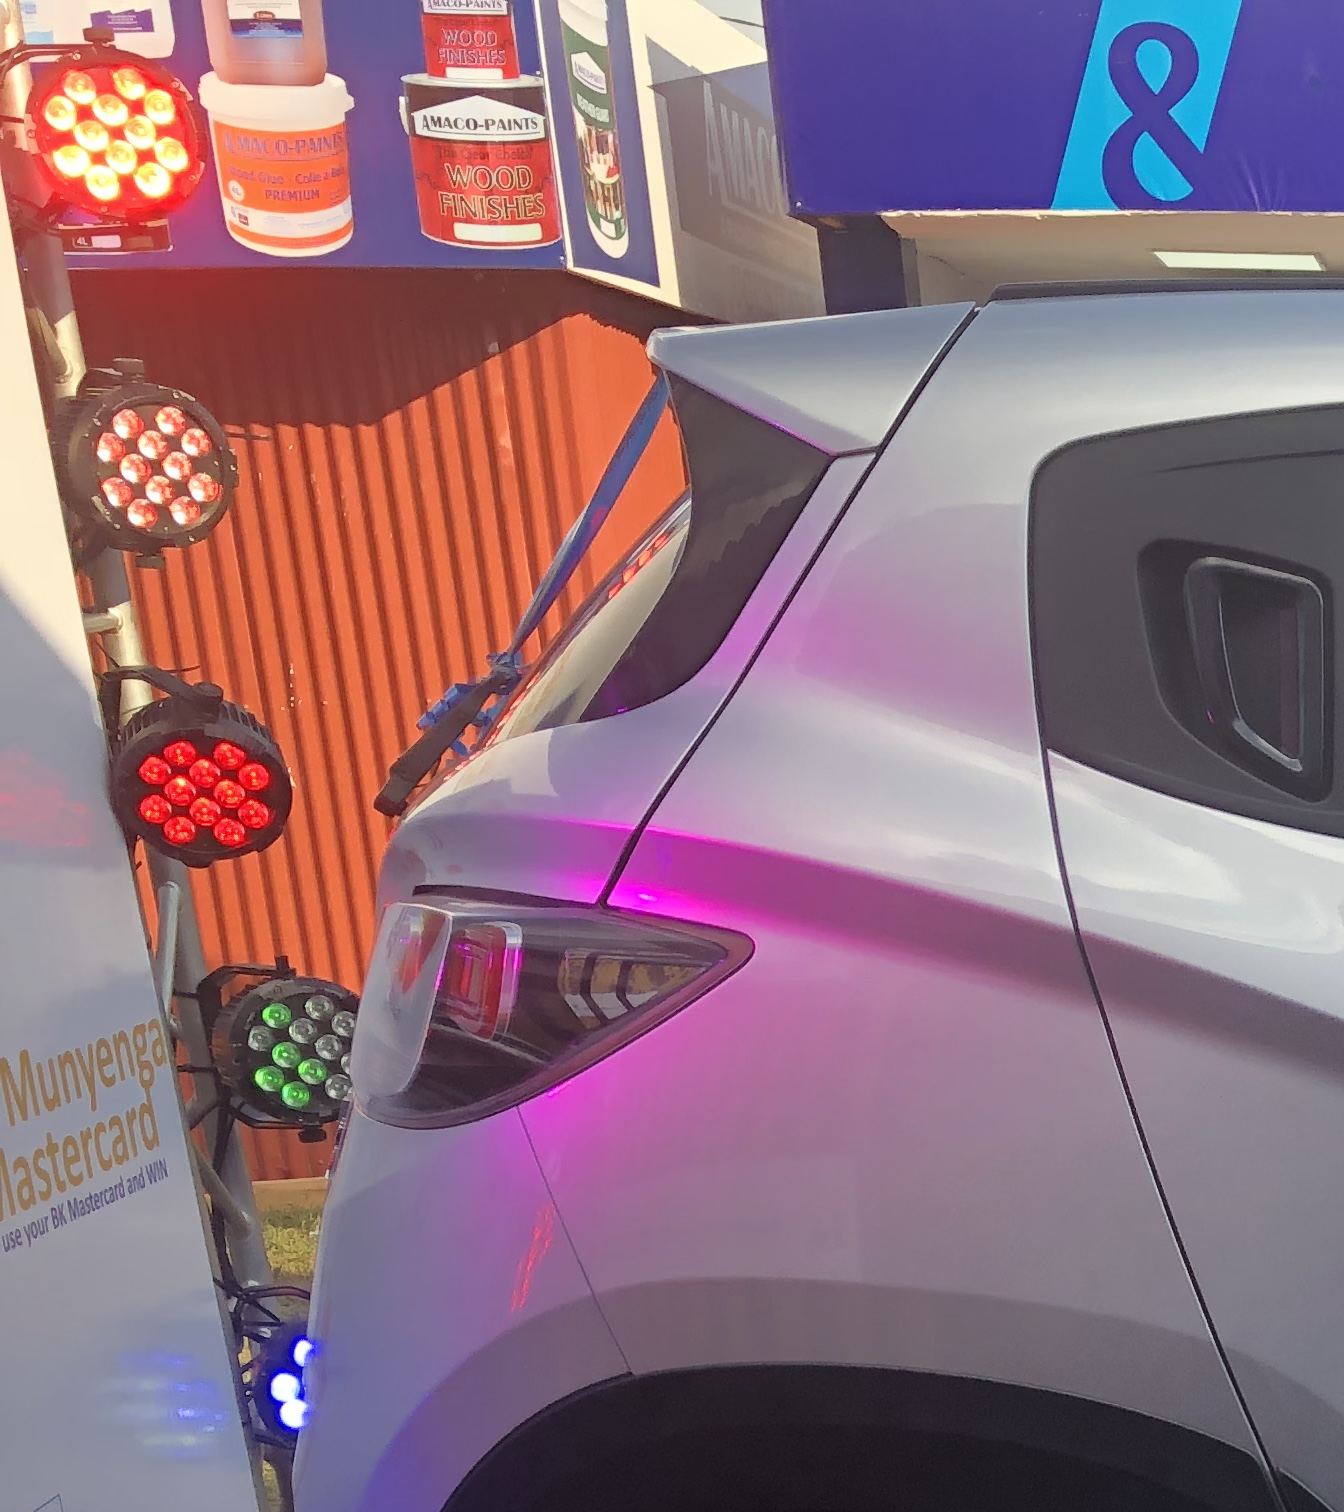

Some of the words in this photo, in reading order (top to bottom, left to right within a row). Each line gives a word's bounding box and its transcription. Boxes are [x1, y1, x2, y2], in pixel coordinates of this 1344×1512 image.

[441, 28, 498, 48] WOOD
[437, 47, 507, 66] FINISHES
[422, 114, 539, 131] AMACO-PAINTS
[444, 163, 533, 190] WOOD
[264, 189, 320, 202] PREMIUM
[438, 191, 546, 220] FINISHES
[0, 1018, 168, 1127] Munyenga
[1, 1229, 23, 1253] use
[23, 1218, 50, 1248] your
[50, 1203, 67, 1230] BK
[67, 1175, 126, 1222] Mastercard
[127, 1167, 146, 1194] and
[146, 1158, 169, 1186] WIN
